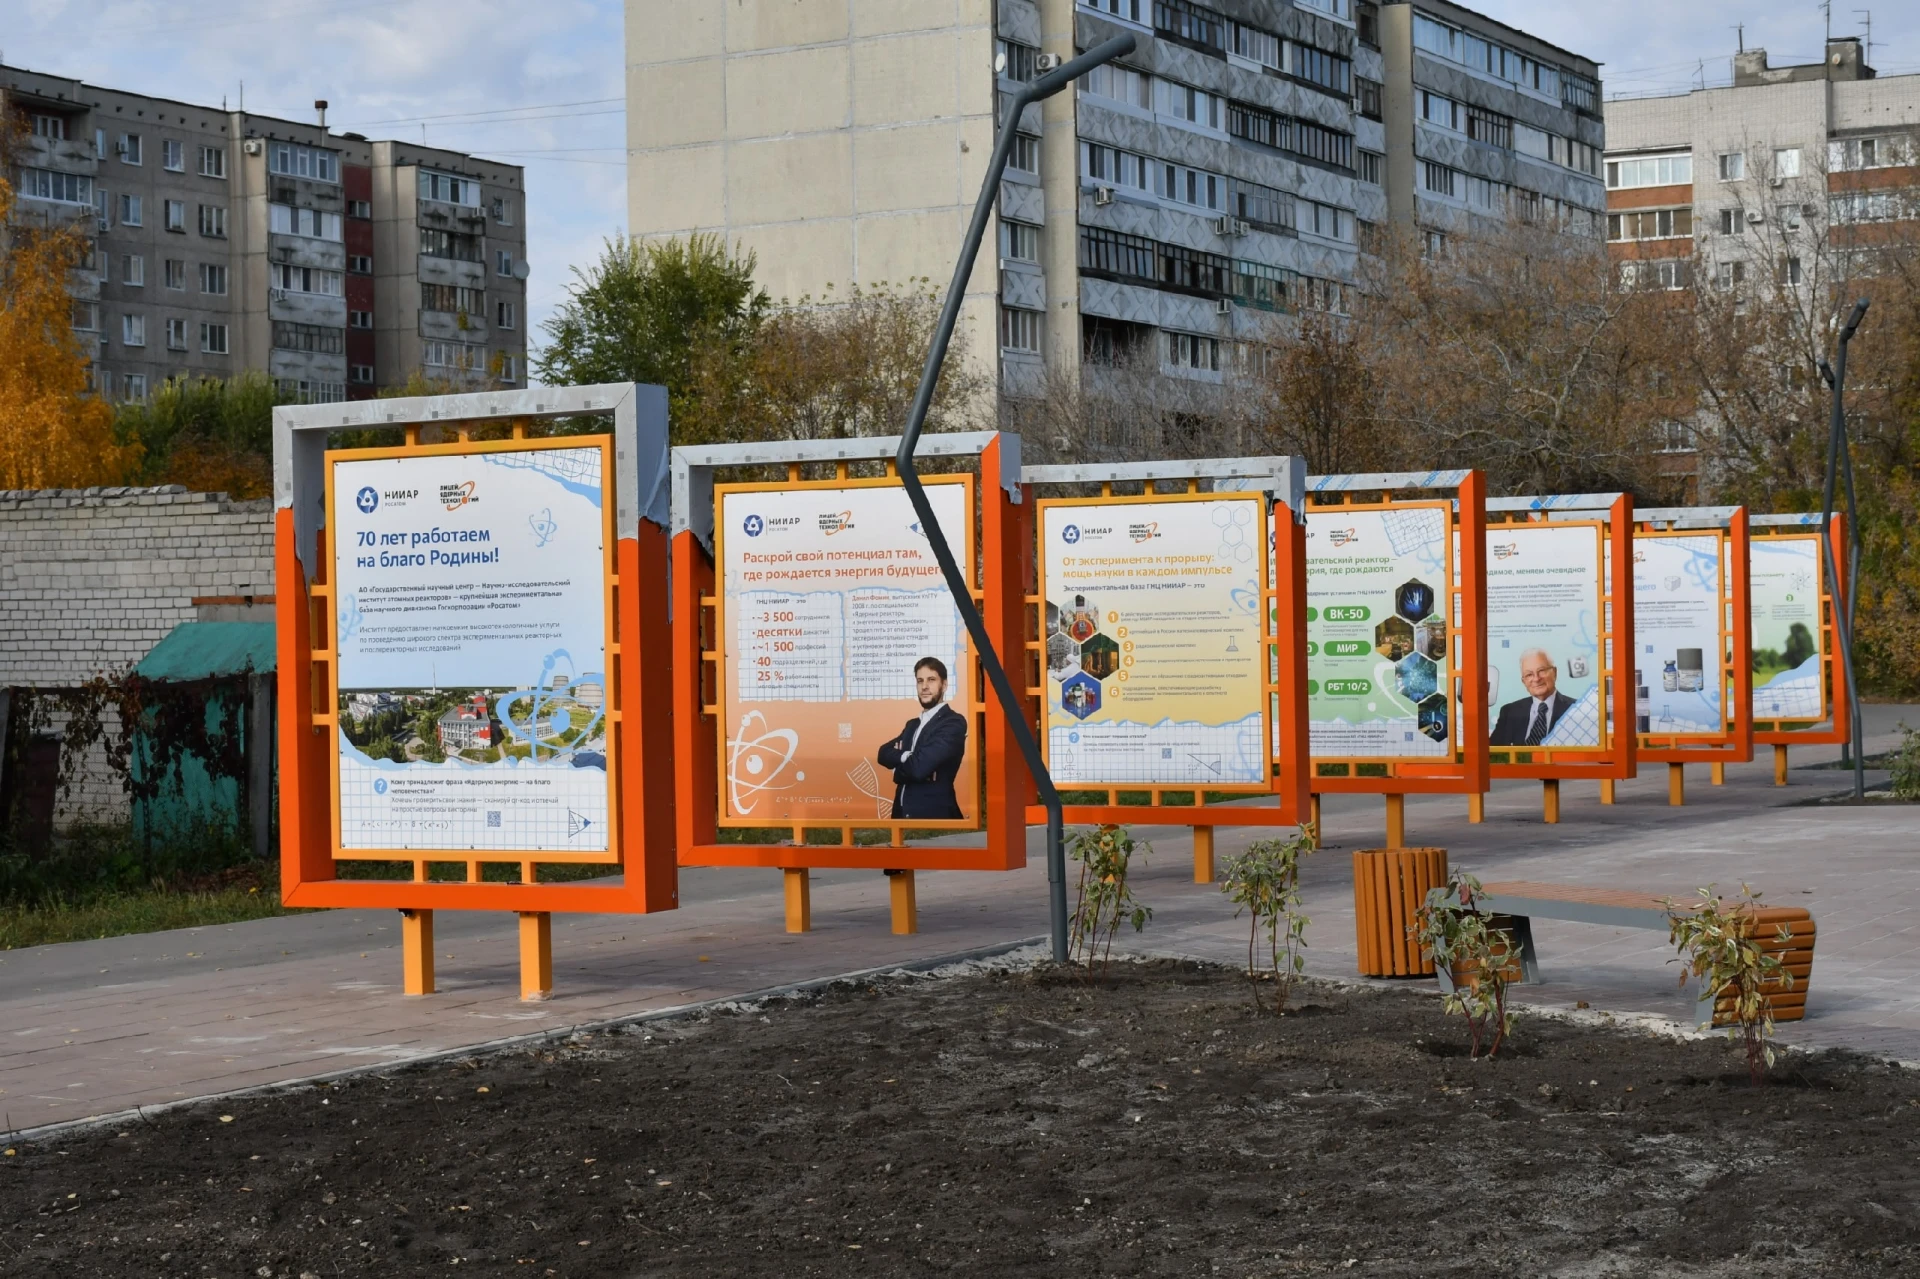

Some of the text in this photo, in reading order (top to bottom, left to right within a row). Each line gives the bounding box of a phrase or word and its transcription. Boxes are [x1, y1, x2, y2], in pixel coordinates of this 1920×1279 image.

[384, 490, 418, 499] НИИАР
[357, 527, 490, 548] 70 лет работаем
[357, 548, 499, 568] на благо Родины!
[744, 550, 922, 565] Раскрой свой потенциал там,
[1063, 557, 1076, 566] От
[1078, 556, 1153, 567] эксперимента
[1164, 555, 1214, 565] прорыву:
[1355, 557, 1390, 566] реактор
[744, 572, 762, 581] где
[766, 568, 831, 582] рождается
[835, 567, 884, 579] энергия
[1064, 570, 1092, 579] мощь
[1094, 570, 1124, 579] науки
[1136, 568, 1178, 577] каждом
[1181, 566, 1232, 576] импульсе
[1345, 566, 1394, 576] рождаются
[427, 584, 454, 592] научный
[482, 579, 570, 590] Научно-исследовательский
[1064, 584, 1128, 592] Экспериментальная
[460, 592, 498, 601] крупнейшая
[774, 612, 793, 622] 500
[1330, 609, 1364, 619] ВК-50
[757, 628, 802, 638] десятки
[774, 642, 794, 652] 500
[1336, 644, 1358, 652] МИР
[758, 656, 770, 666] 40
[758, 671, 770, 681] 25
[774, 670, 784, 680] %
[1328, 682, 1368, 692] РБТ 10/2
